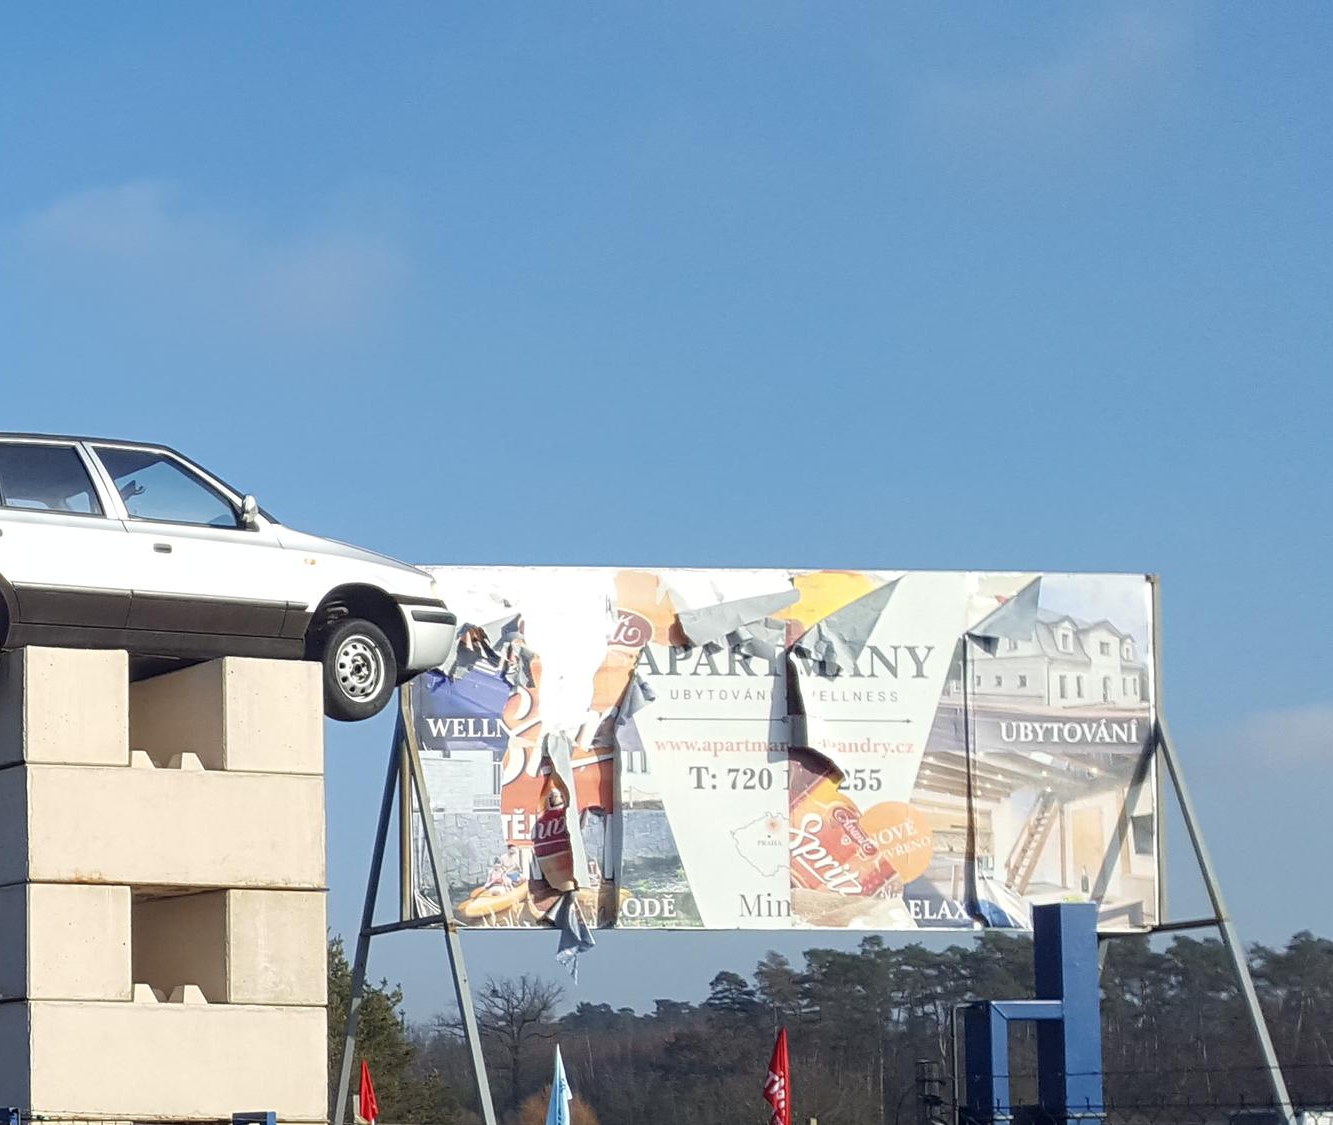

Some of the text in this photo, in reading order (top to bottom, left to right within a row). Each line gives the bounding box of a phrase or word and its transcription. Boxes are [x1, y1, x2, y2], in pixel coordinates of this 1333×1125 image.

[999, 718, 1140, 744] UBYTOVÁNÍ
[689, 766, 717, 790] T:
[727, 767, 773, 791] 720
